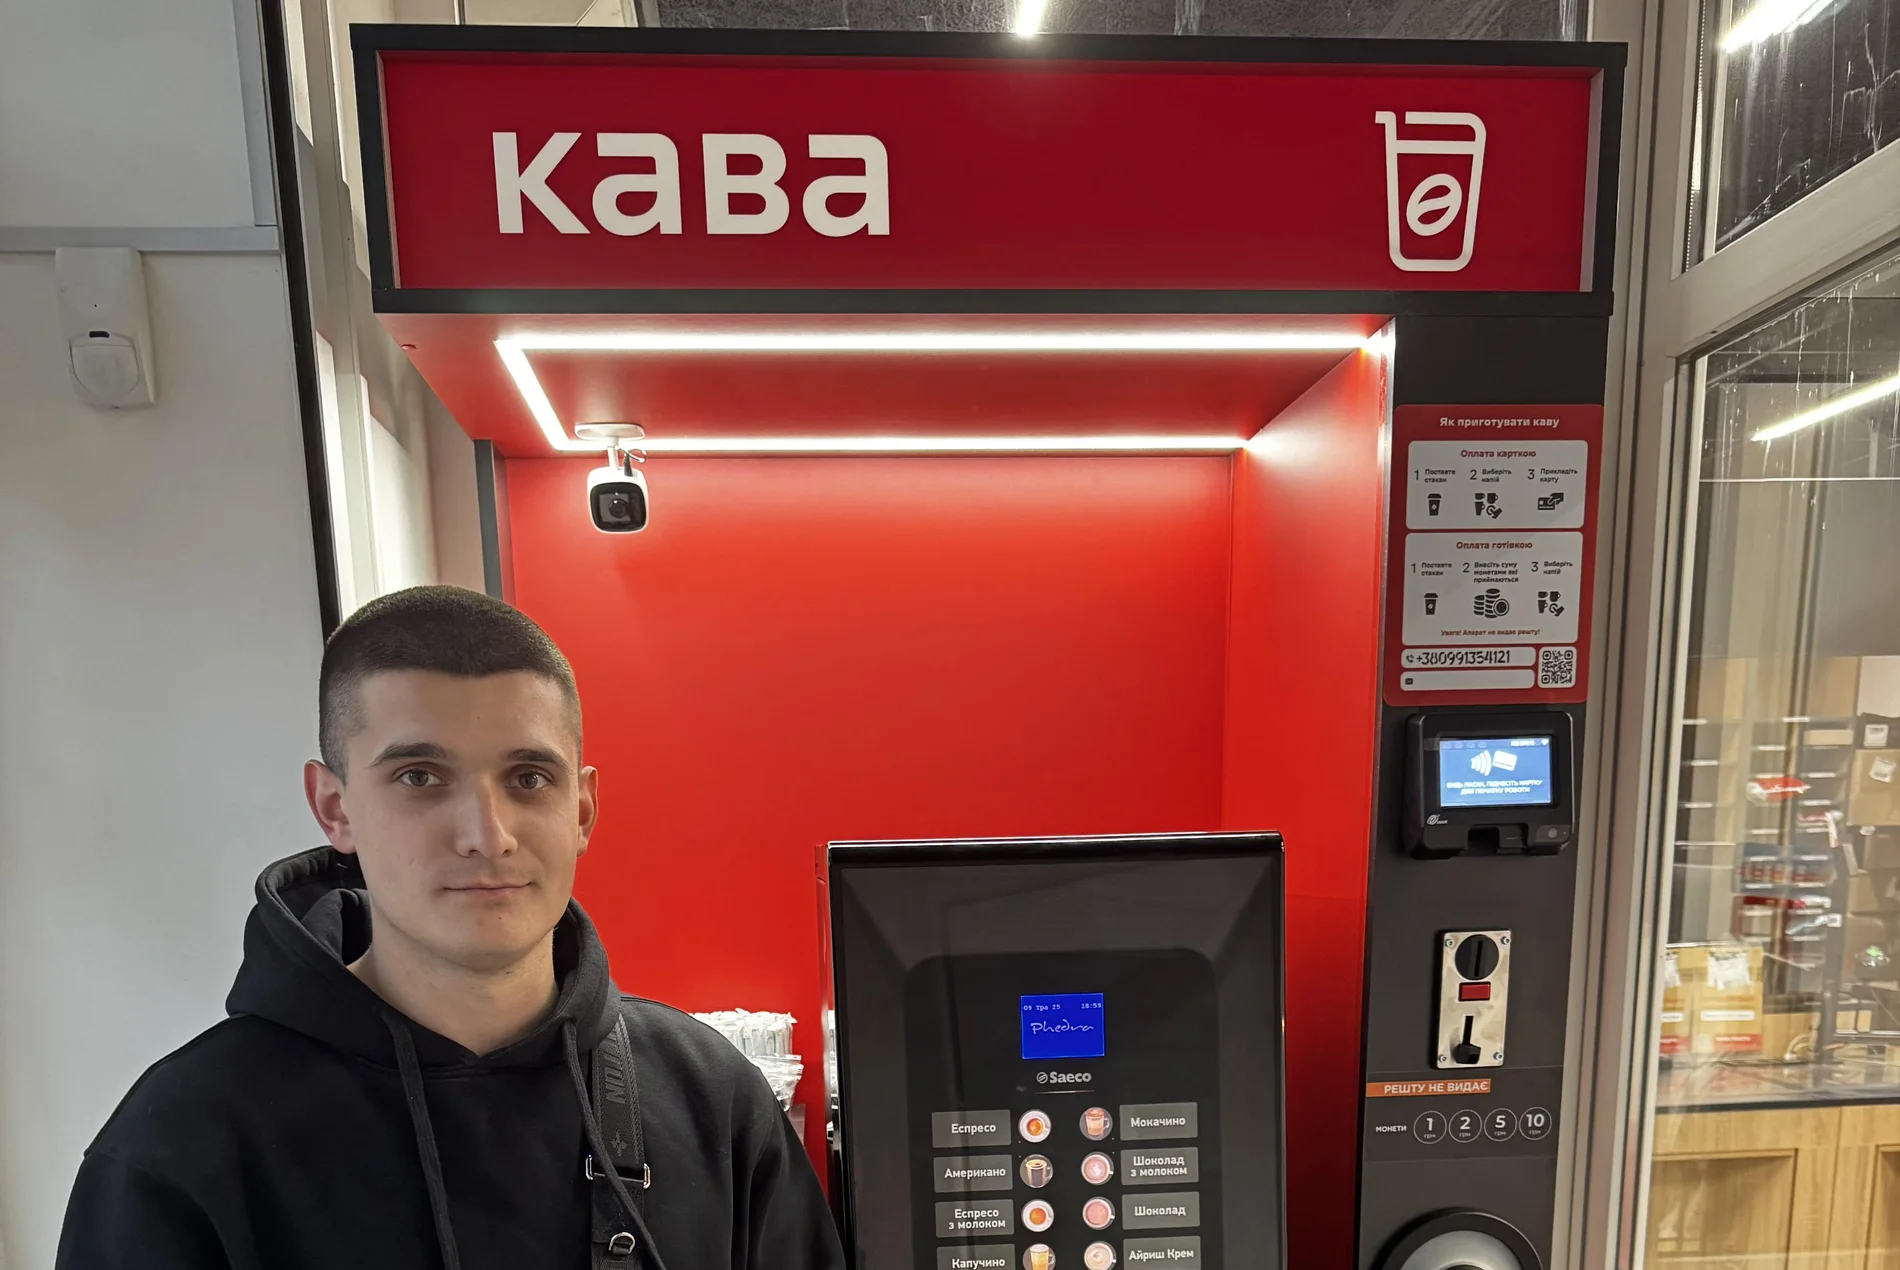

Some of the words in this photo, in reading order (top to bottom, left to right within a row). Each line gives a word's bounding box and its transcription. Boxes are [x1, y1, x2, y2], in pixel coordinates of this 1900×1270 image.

[1440, 417, 1454, 426] Як
[1458, 418, 1530, 428] приготувати
[1533, 418, 1560, 428] каву
[1460, 450, 1494, 458] Оплата
[1497, 450, 1536, 459] карткою
[1413, 470, 1419, 480] 1
[1469, 469, 1477, 480] 2
[1527, 469, 1535, 480] 3
[1539, 476, 1559, 484] карту
[1456, 541, 1489, 549] Оплата
[1492, 541, 1533, 549] готівкою
[1411, 563, 1416, 573] 1
[1462, 562, 1470, 573] 2
[1531, 561, 1539, 572] 3
[1517, 628, 1540, 636] решту!
[1416, 650, 1510, 665] +380991354121
[1030, 1018, 1094, 1035] Phedra
[1049, 1071, 1092, 1084] Saeco
[1384, 1084, 1425, 1094] РЕШТУ
[1428, 1083, 1444, 1093] НЕ
[1447, 1081, 1488, 1092] ВИДАЄ
[1130, 1115, 1186, 1128] Мокачино
[1426, 1117, 1433, 1131] 1
[1459, 1116, 1471, 1130] 2
[1495, 1115, 1506, 1129] 5
[1525, 1113, 1545, 1128] 10
[951, 1122, 996, 1137] Еспресо
[1375, 1125, 1407, 1133] МОНЕТИ
[1133, 1155, 1185, 1168] Шоколад
[944, 1167, 1006, 1180] Американо
[1130, 1168, 1137, 1177] з
[1139, 1165, 1188, 1177] молоком
[954, 1208, 999, 1222] Еспресо
[1134, 1204, 1186, 1218] Шоколад
[948, 1221, 955, 1230] з
[957, 1218, 1006, 1229] молоком
[1128, 1247, 1165, 1261] Айриш
[1167, 1247, 1194, 1260] Крем
[951, 1256, 1005, 1270] Капучино
